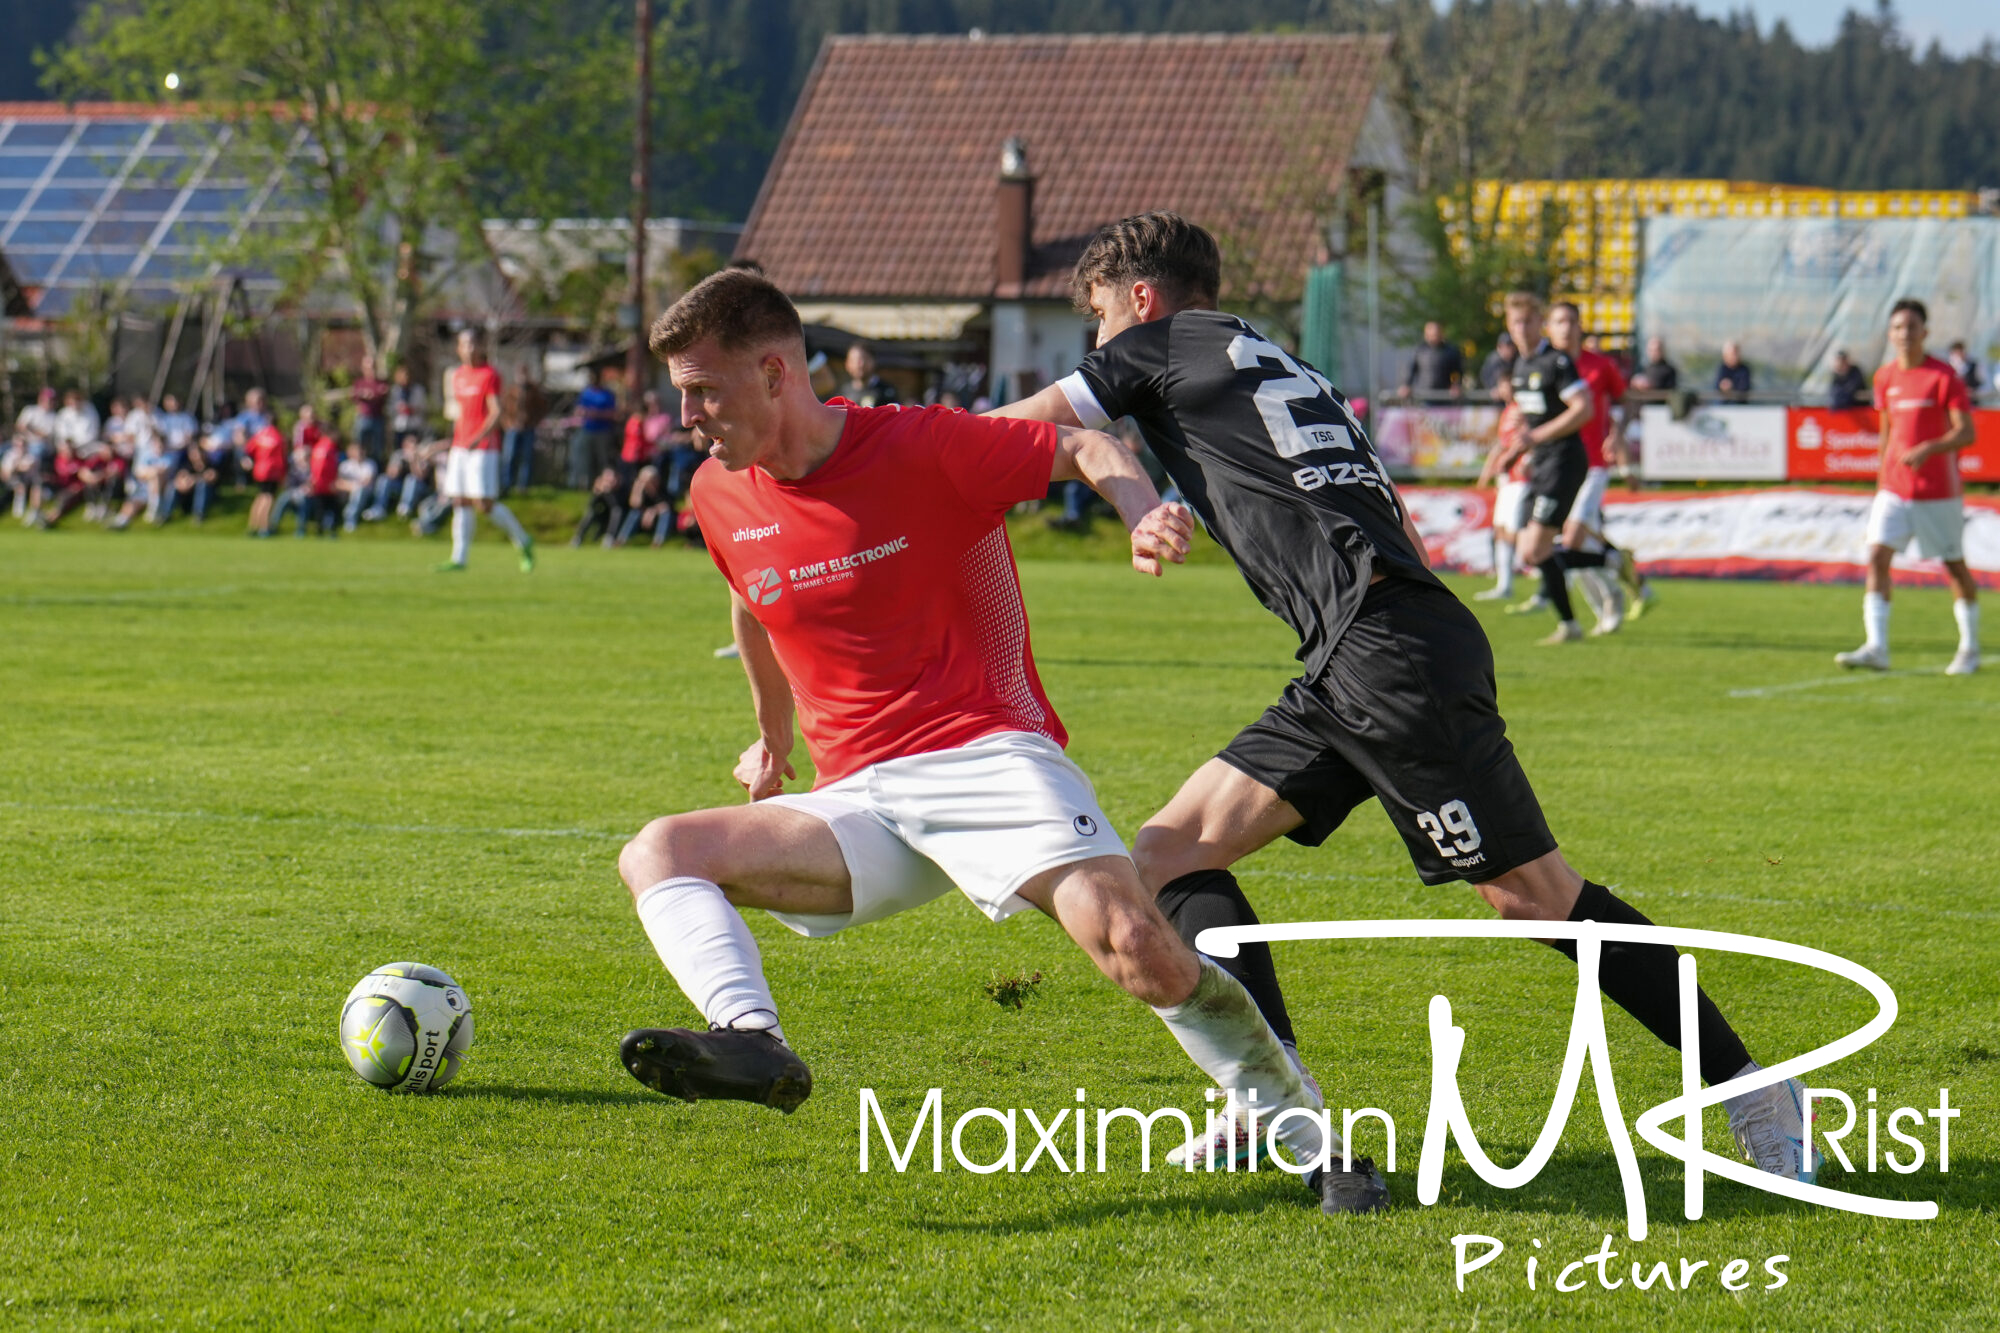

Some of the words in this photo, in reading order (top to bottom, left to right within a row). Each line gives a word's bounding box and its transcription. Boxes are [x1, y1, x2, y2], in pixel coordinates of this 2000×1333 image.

[1311, 430, 1335, 444] TSG
[732, 522, 780, 543] uhlsport
[789, 561, 828, 583] RAWE
[829, 536, 909, 573] ELECTRONIC
[793, 578, 825, 592] DEMMEL
[826, 571, 854, 585] GRUPPE
[1416, 799, 1482, 858] 29
